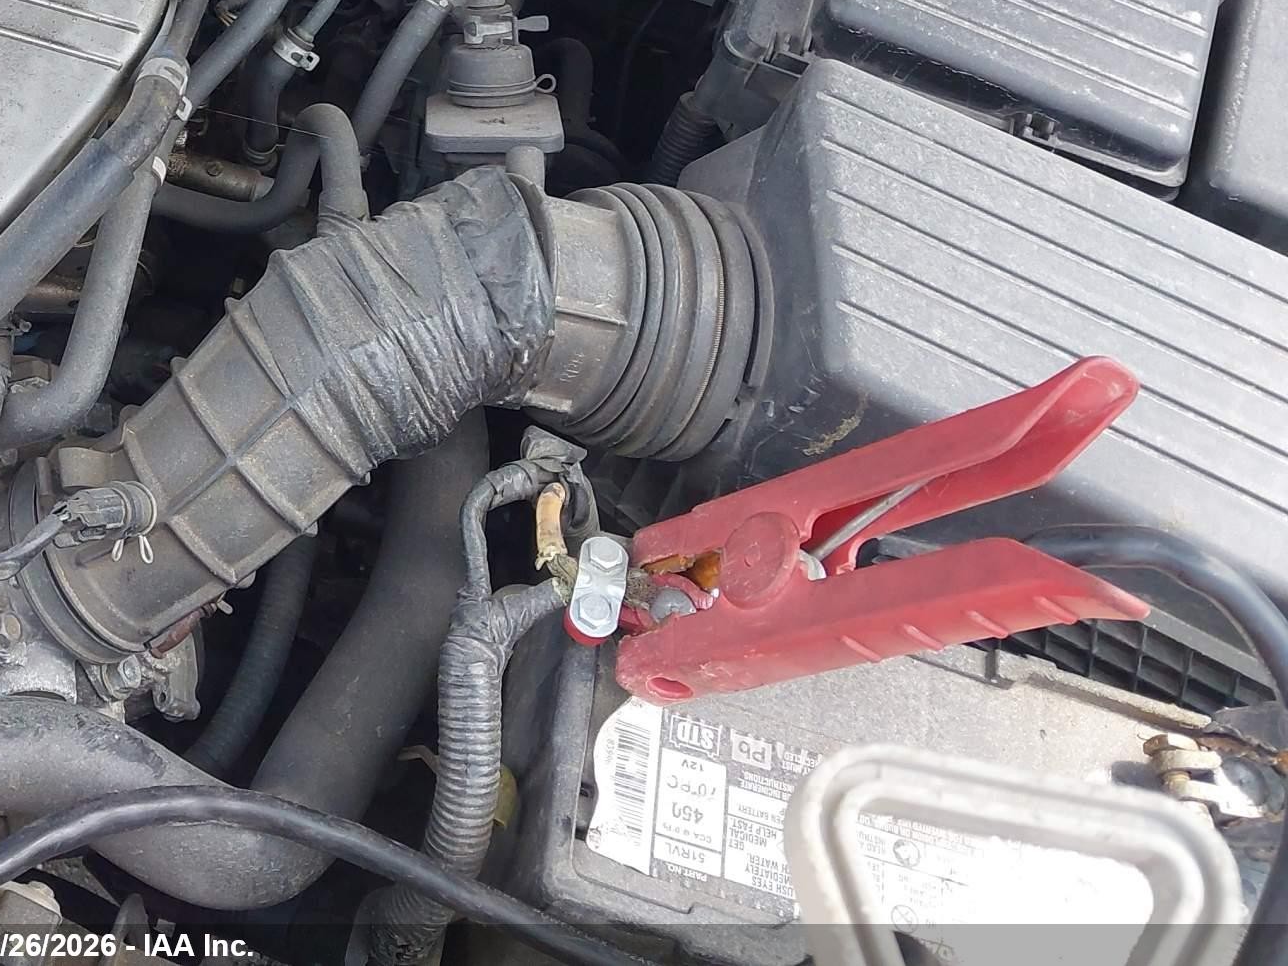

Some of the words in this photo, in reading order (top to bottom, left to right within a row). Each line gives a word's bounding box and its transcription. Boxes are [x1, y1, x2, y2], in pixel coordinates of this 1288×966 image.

[737, 740, 765, 763] Pb
[681, 758, 704, 772] 12V
[784, 752, 815, 767] ECYCLED
[730, 818, 753, 831] FAST.
[728, 827, 767, 846] MEDICAL
[755, 826, 777, 839] HELP
[728, 838, 745, 850] GET
[665, 842, 705, 862] 51RVL
[747, 853, 779, 868] WATER.
[682, 869, 707, 882] PART
[745, 863, 791, 884] MEDIATELY
[751, 876, 773, 889] EYES
